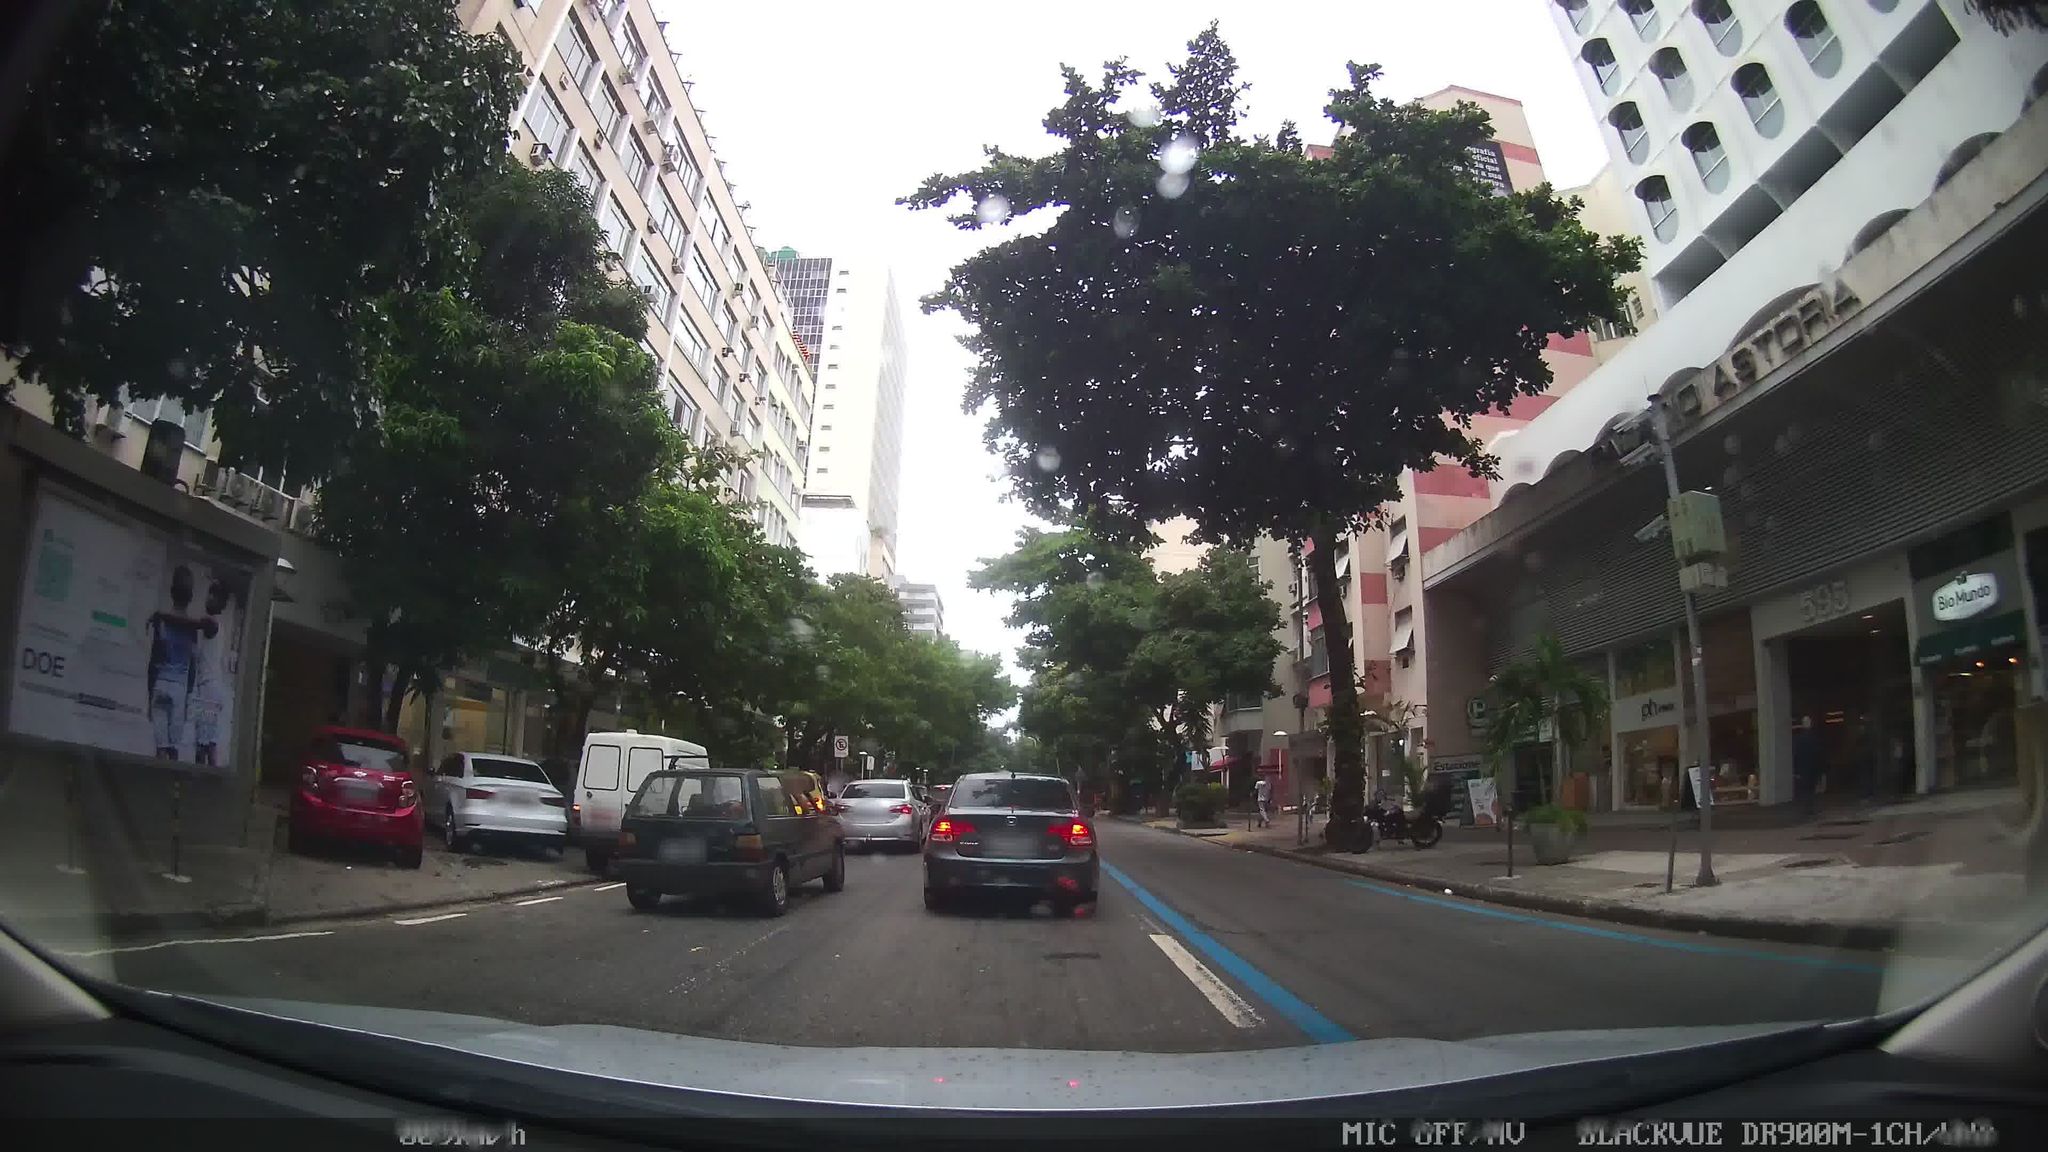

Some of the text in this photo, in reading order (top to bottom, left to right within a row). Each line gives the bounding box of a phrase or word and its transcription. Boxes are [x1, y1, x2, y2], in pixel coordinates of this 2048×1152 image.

[1938, 585, 1991, 611] Bio Mundo
[22, 647, 66, 679] DOE
